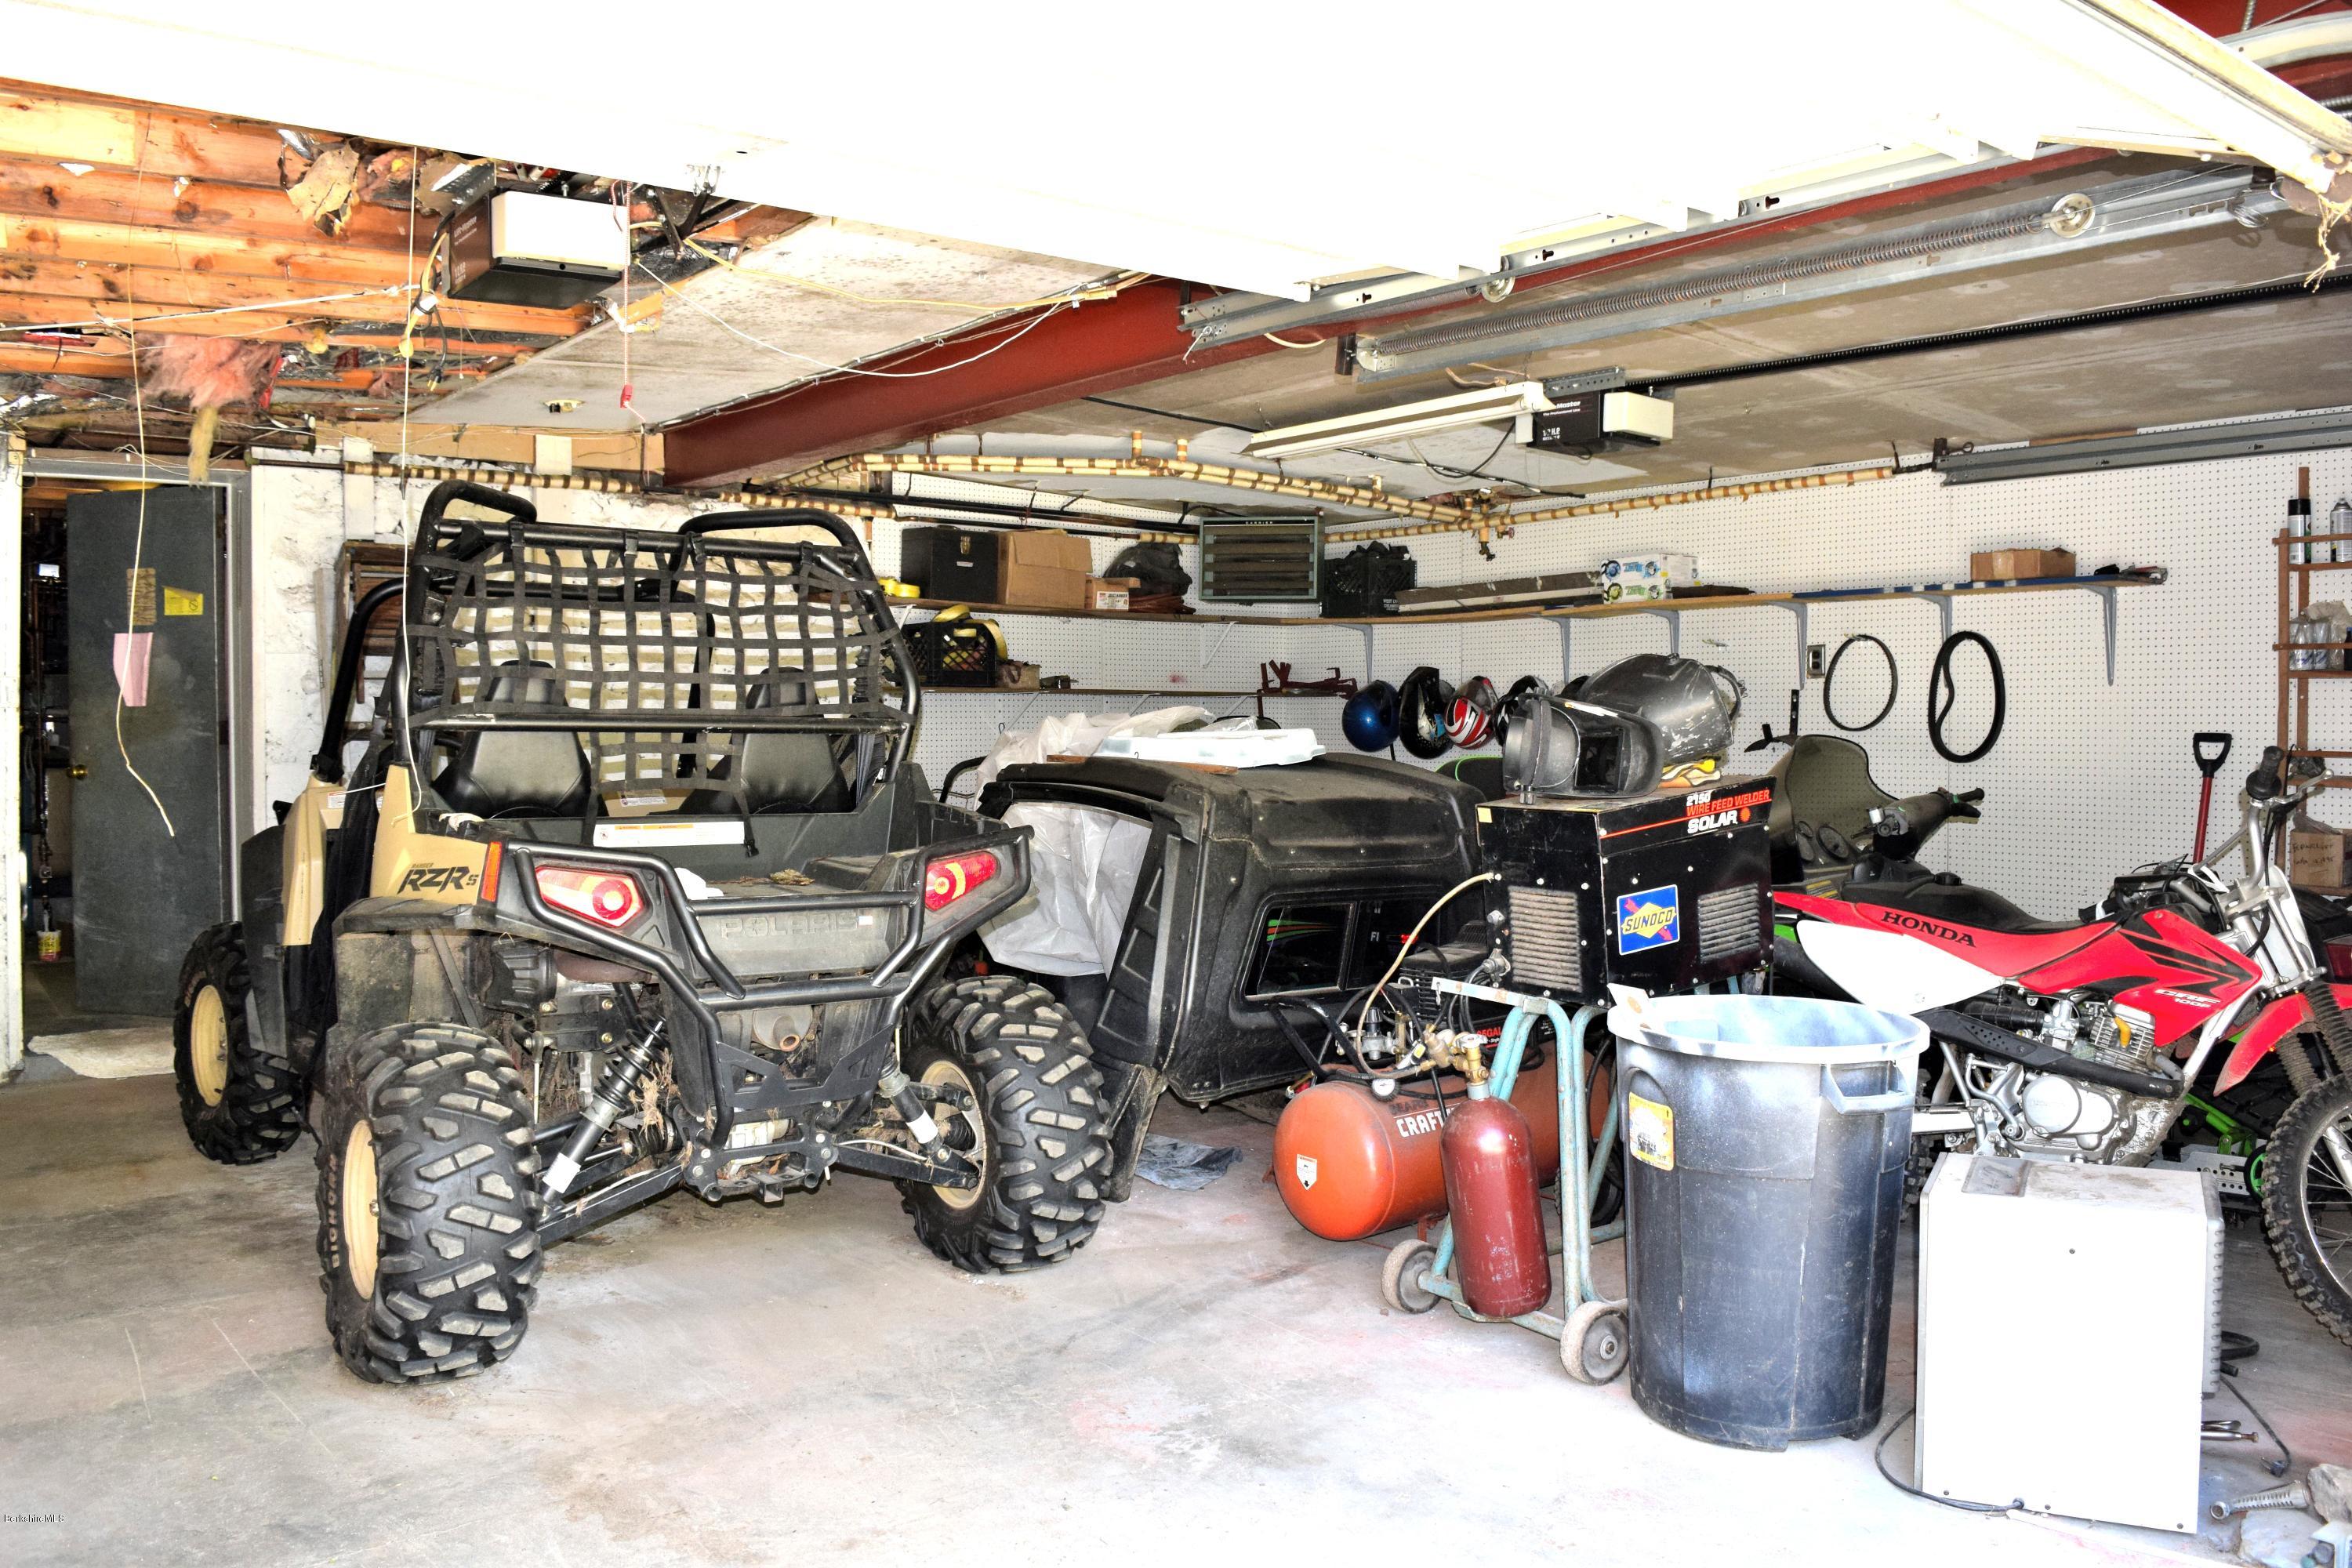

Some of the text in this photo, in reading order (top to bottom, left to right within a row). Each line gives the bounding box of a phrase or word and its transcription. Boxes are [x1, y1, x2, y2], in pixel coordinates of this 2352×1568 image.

[1687, 789, 1770, 817] WIRE FEED WELDER
[1687, 810, 1737, 834] SOLAR
[720, 909, 858, 940] POLARIS
[1624, 909, 1673, 932] SUNOCO
[1881, 910, 1976, 948] HONDA
[2154, 989, 2221, 1004] CRF
[2174, 998, 2212, 1008] 100F
[1396, 1108, 1455, 1138] CRAFT
